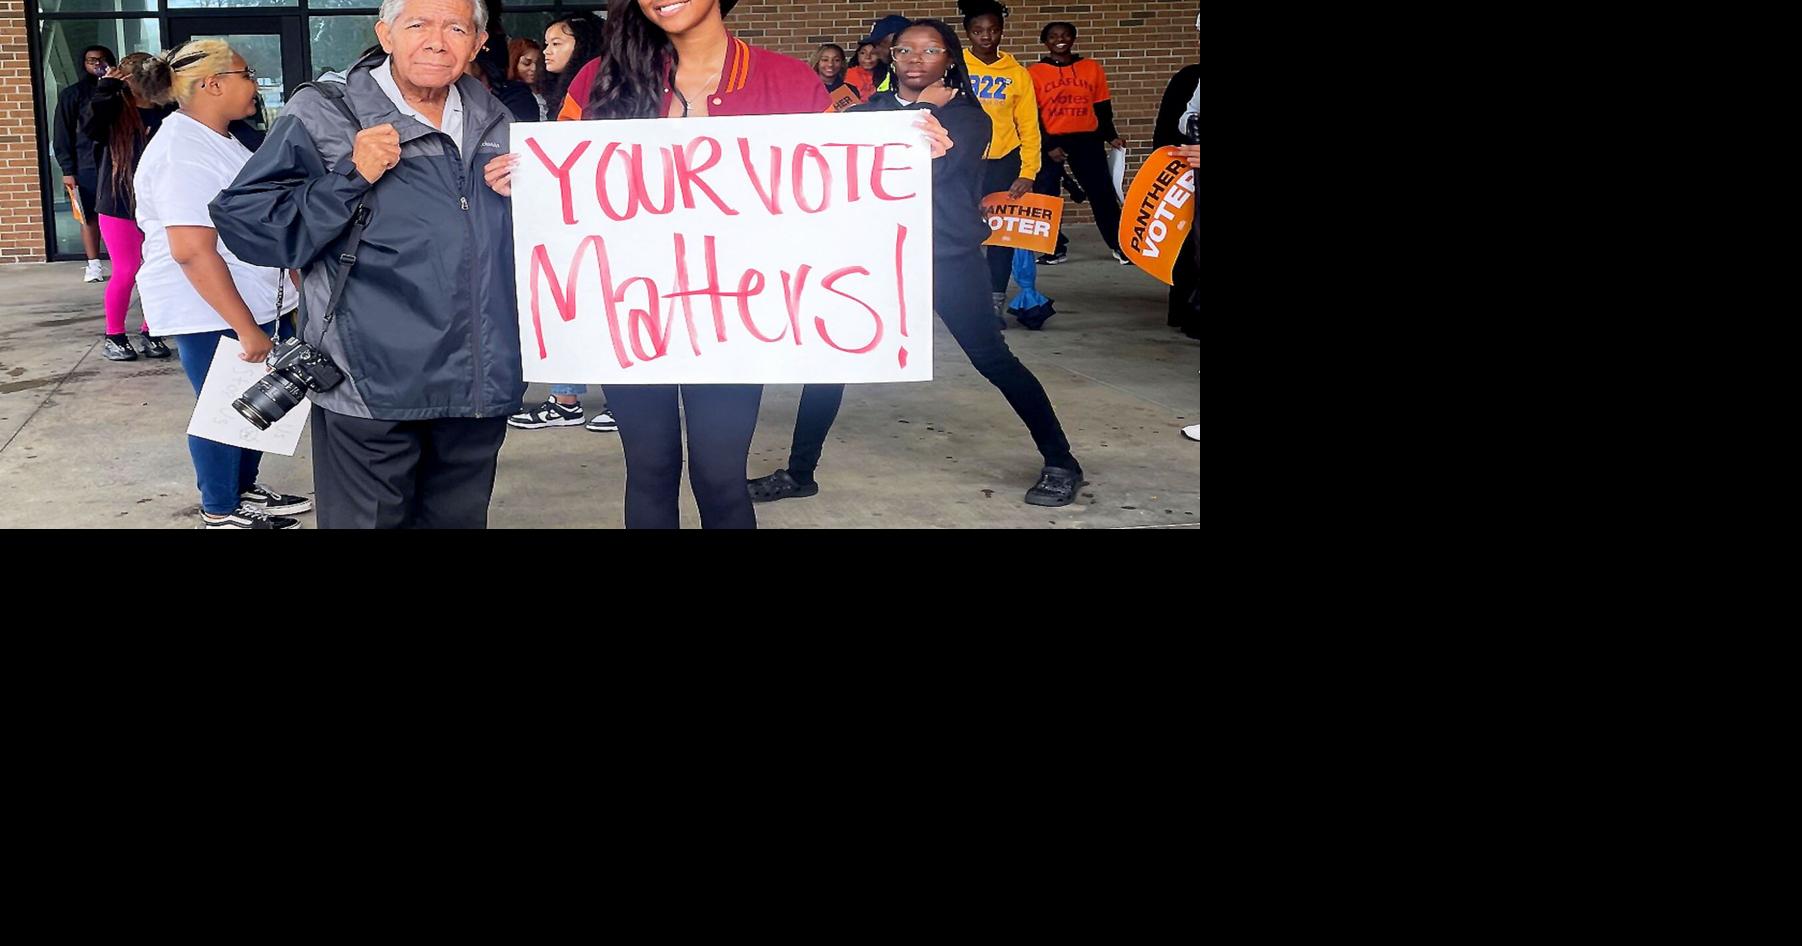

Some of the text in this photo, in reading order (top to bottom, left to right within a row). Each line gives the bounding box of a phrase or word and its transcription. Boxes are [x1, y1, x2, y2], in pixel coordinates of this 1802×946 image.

[525, 136, 916, 225] YOUR VOTE
[984, 204, 1053, 220] ANTHER
[1130, 159, 1187, 253] PANTHER
[1142, 169, 1195, 258] VOTER
[984, 216, 1051, 238] OTER
[530, 223, 908, 369] Matters!
